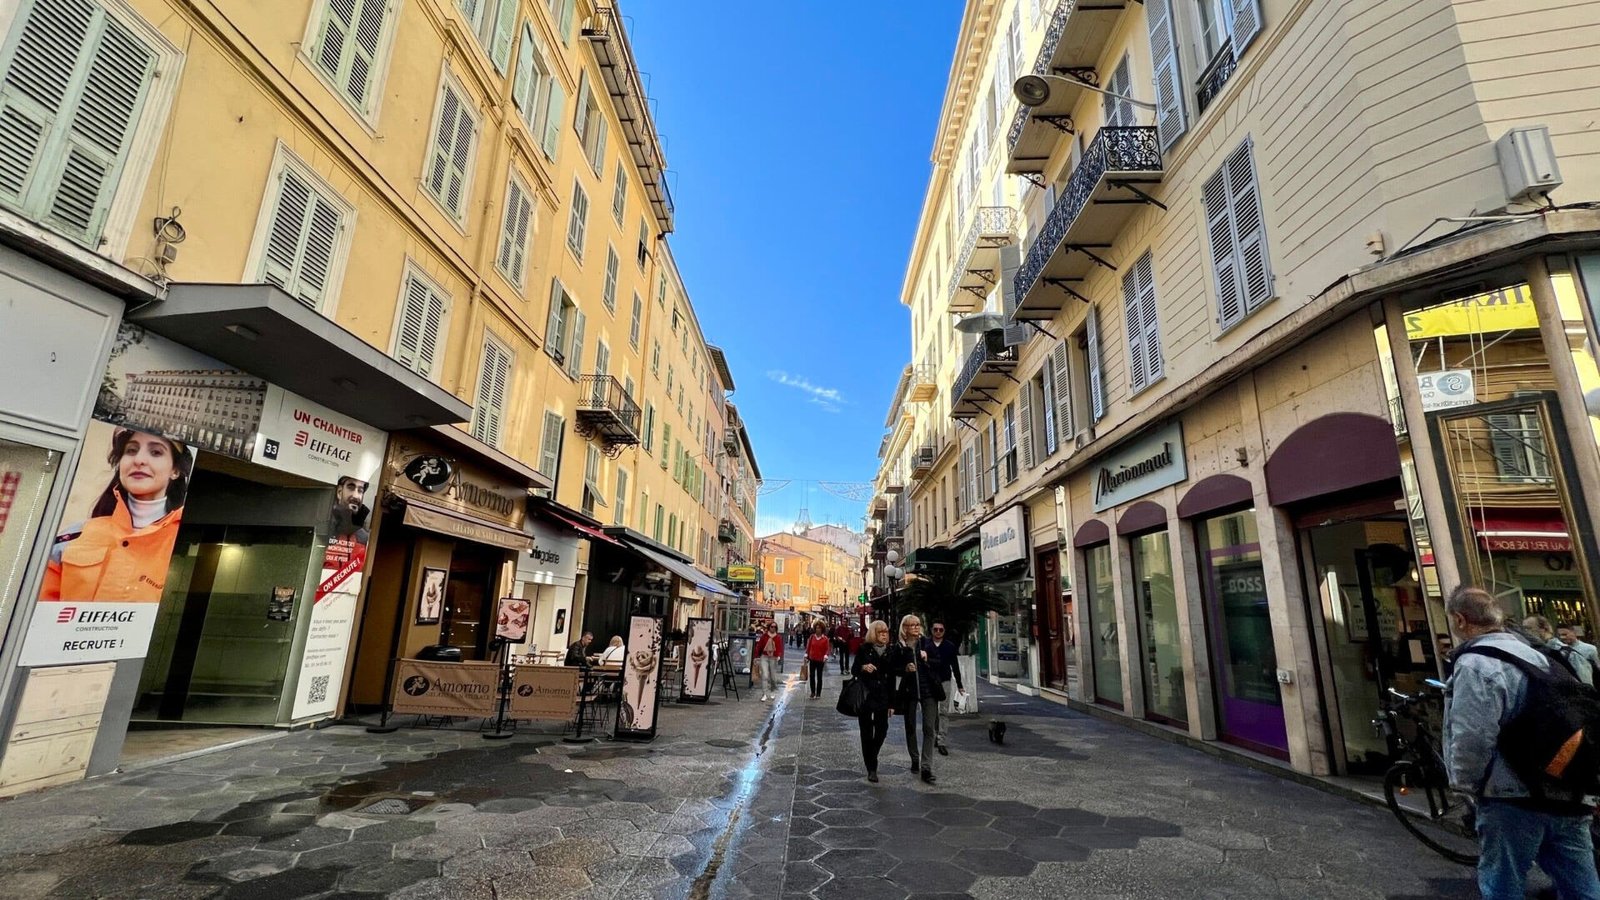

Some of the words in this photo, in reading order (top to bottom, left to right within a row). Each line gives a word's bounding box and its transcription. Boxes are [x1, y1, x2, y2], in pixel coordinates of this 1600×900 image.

[293, 409, 311, 425] UN
[313, 417, 363, 445] CHANTIER
[265, 443, 278, 455] 33
[309, 438, 352, 462] EIFFAGE
[307, 453, 340, 467] CONSTRUCTION
[1095, 441, 1173, 505] Marionnaud
[443, 468, 515, 518] Amorino
[323, 580, 334, 592] ON
[332, 559, 358, 584] RECRUTE
[1228, 576, 1263, 593] BOSS
[78, 610, 136, 623] EIFFAGE
[62, 639, 117, 651] RECRUTE
[430, 678, 490, 694] Amorino
[533, 685, 571, 695] Amorino
